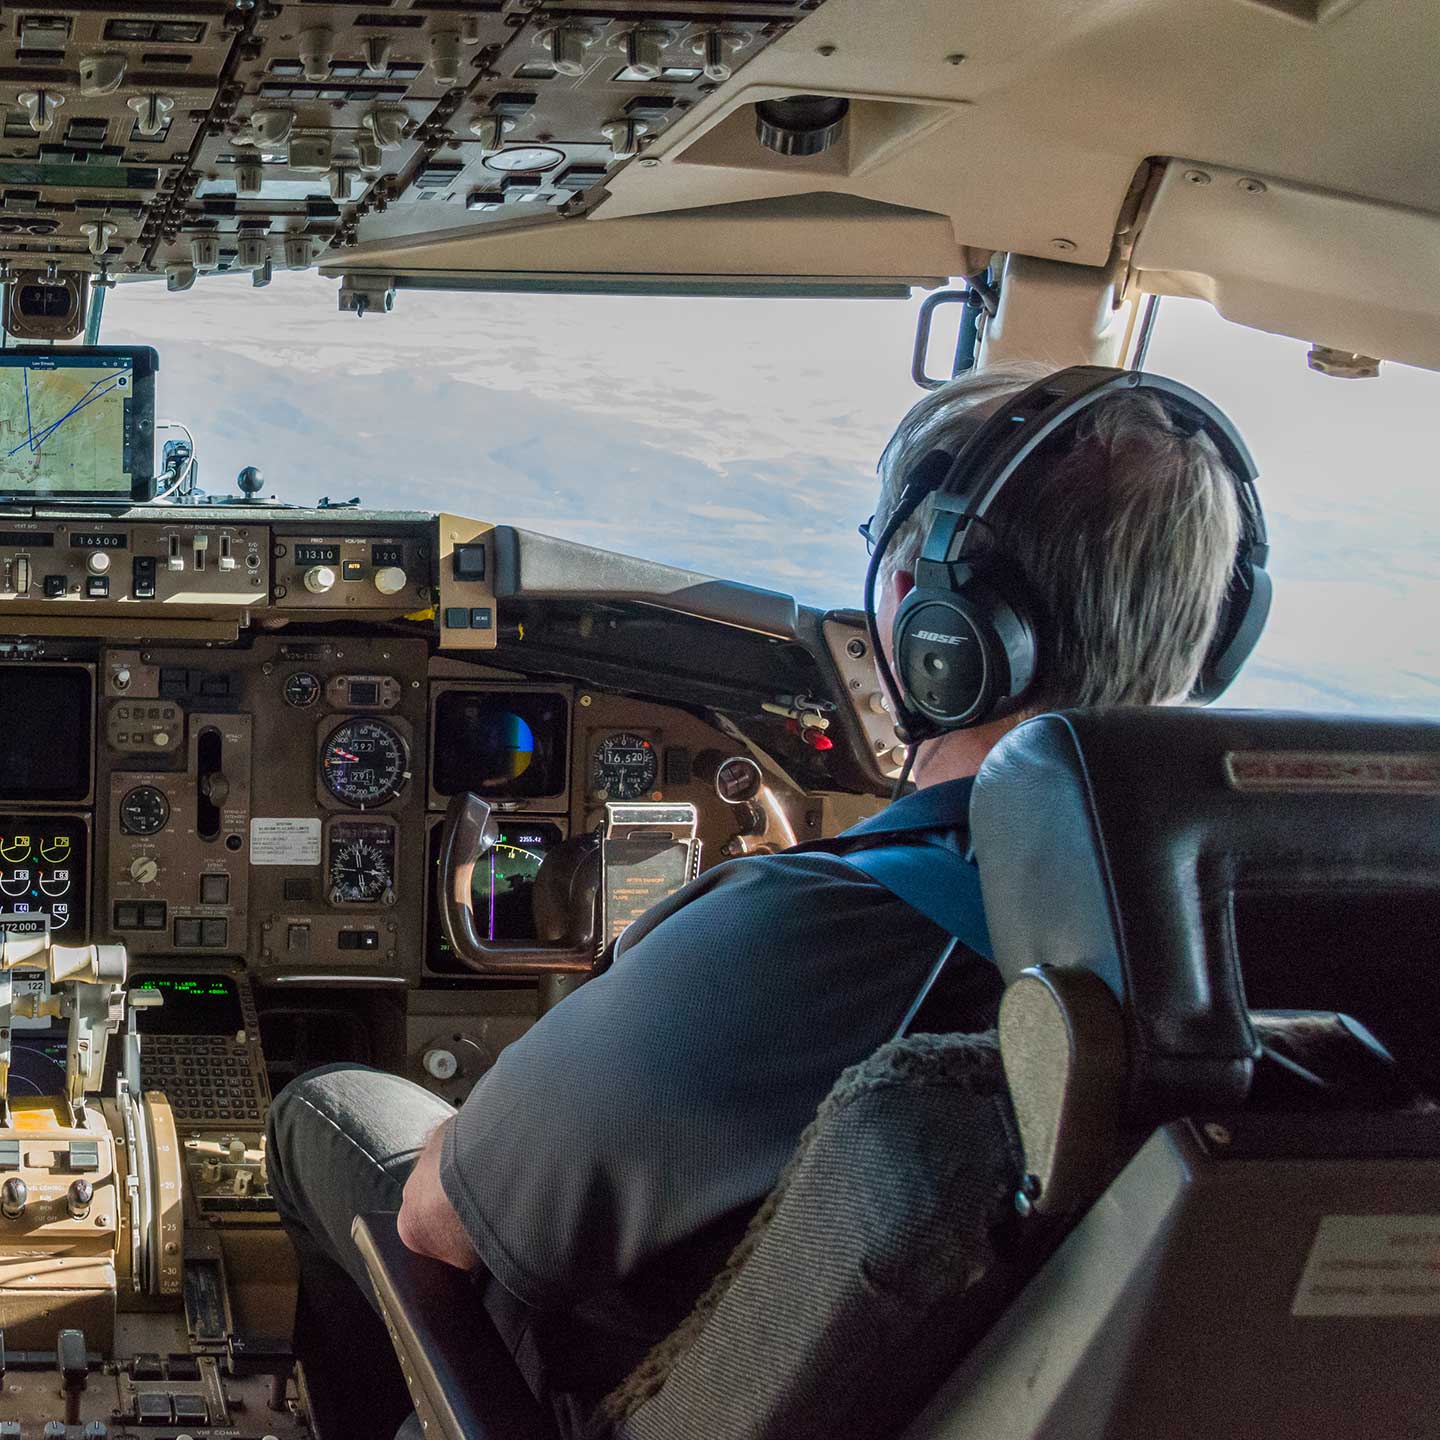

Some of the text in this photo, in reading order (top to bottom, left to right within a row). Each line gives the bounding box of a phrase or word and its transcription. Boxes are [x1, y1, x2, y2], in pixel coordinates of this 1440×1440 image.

[80, 536, 118, 545] 16500
[298, 550, 333, 560] 113.10
[376, 552, 397, 560] 120
[911, 630, 968, 645] BOSE
[28, 982, 43, 990] 122
